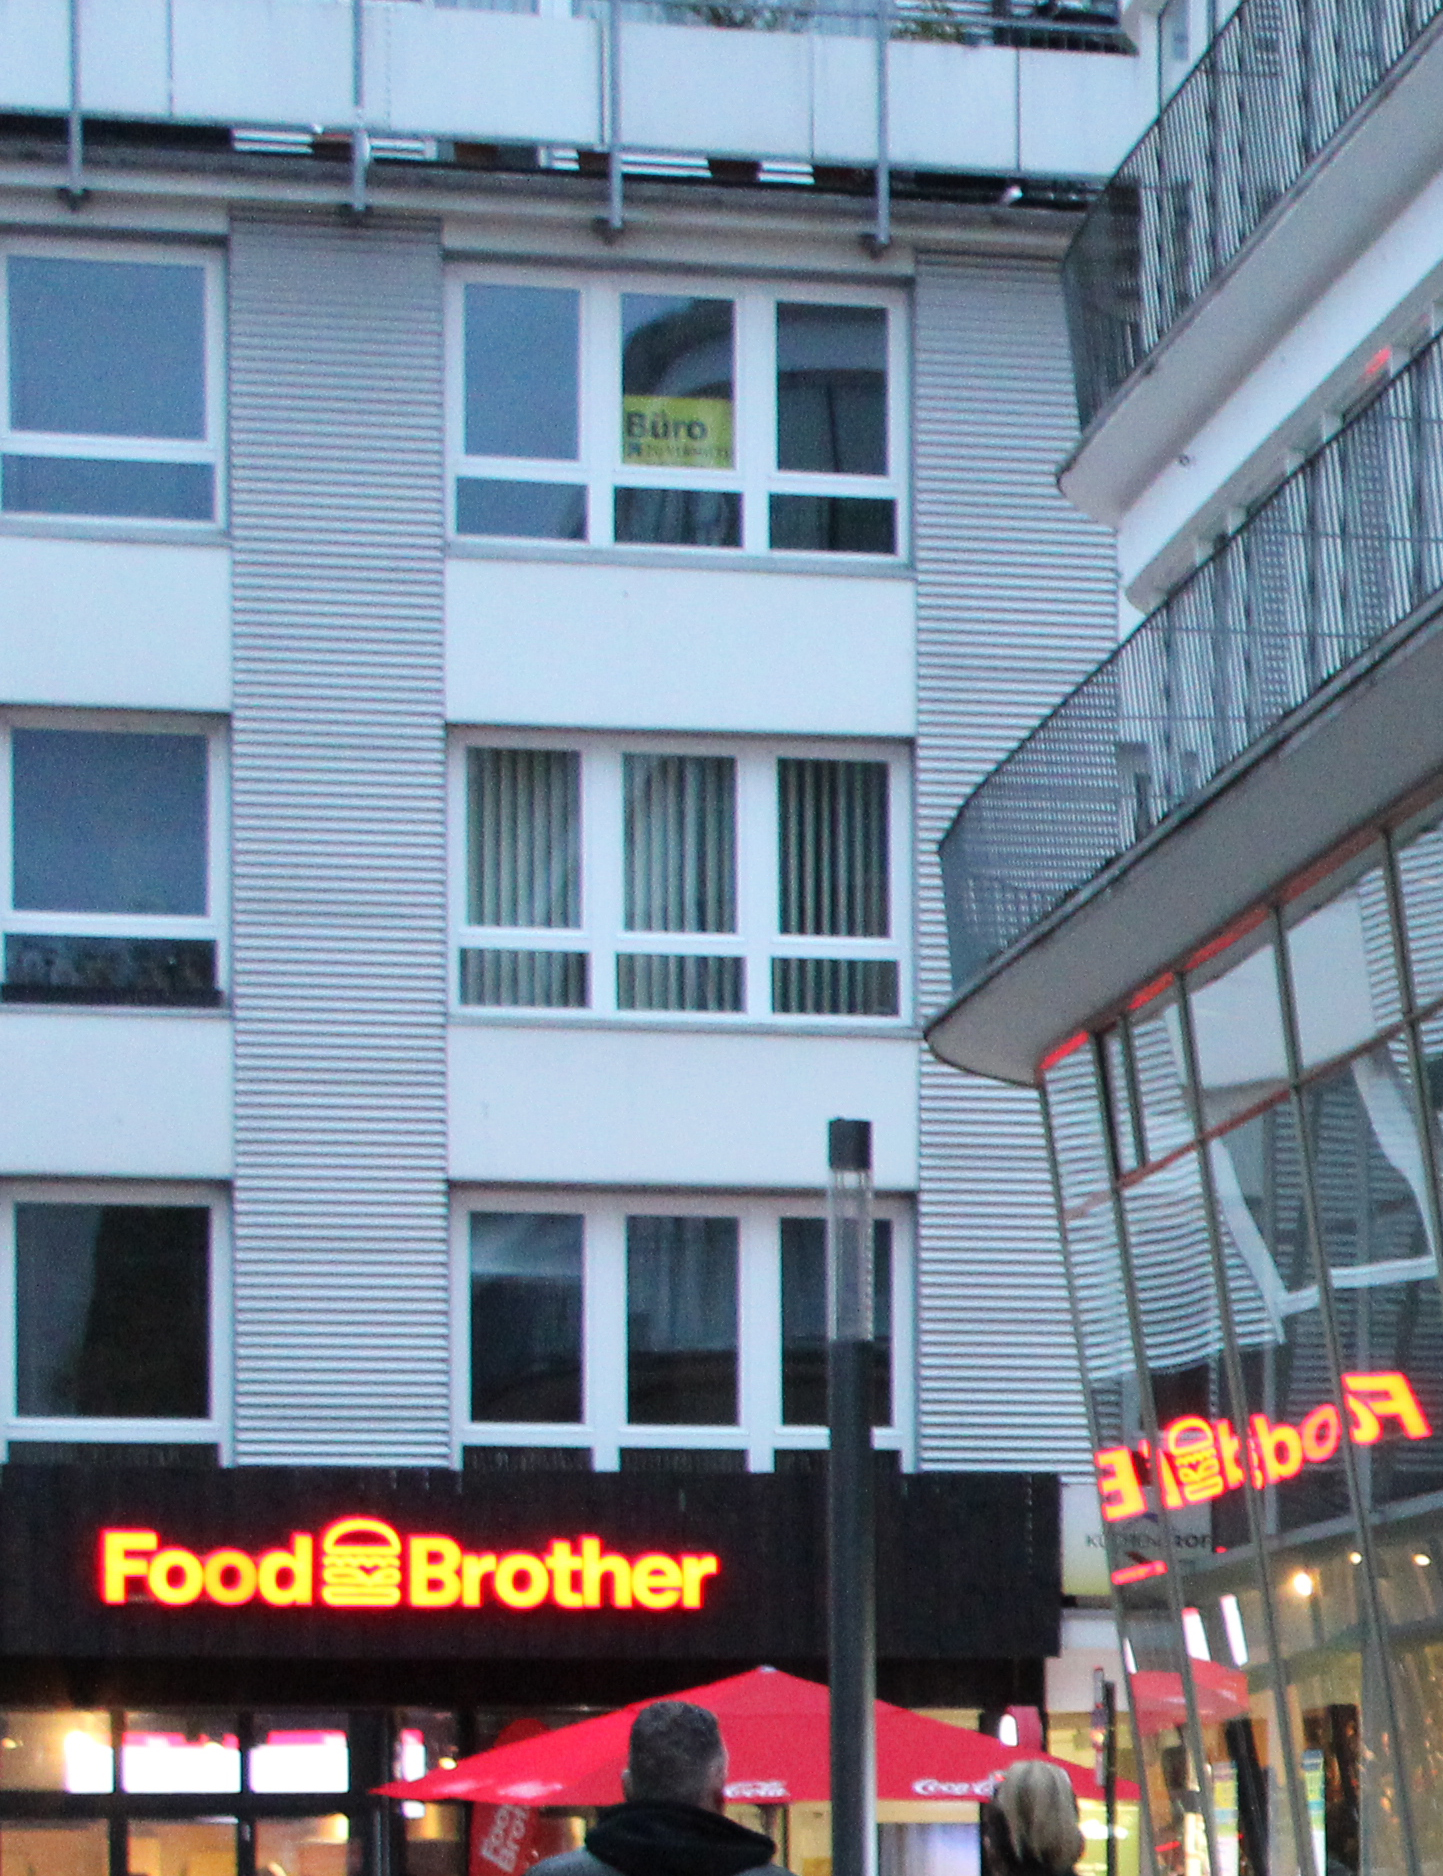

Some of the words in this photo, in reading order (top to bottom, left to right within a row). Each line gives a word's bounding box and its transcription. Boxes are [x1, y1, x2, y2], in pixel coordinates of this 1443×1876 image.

[626, 409, 709, 441] Büro
[100, 1528, 314, 1607] Food
[408, 1535, 719, 1610] Brother
